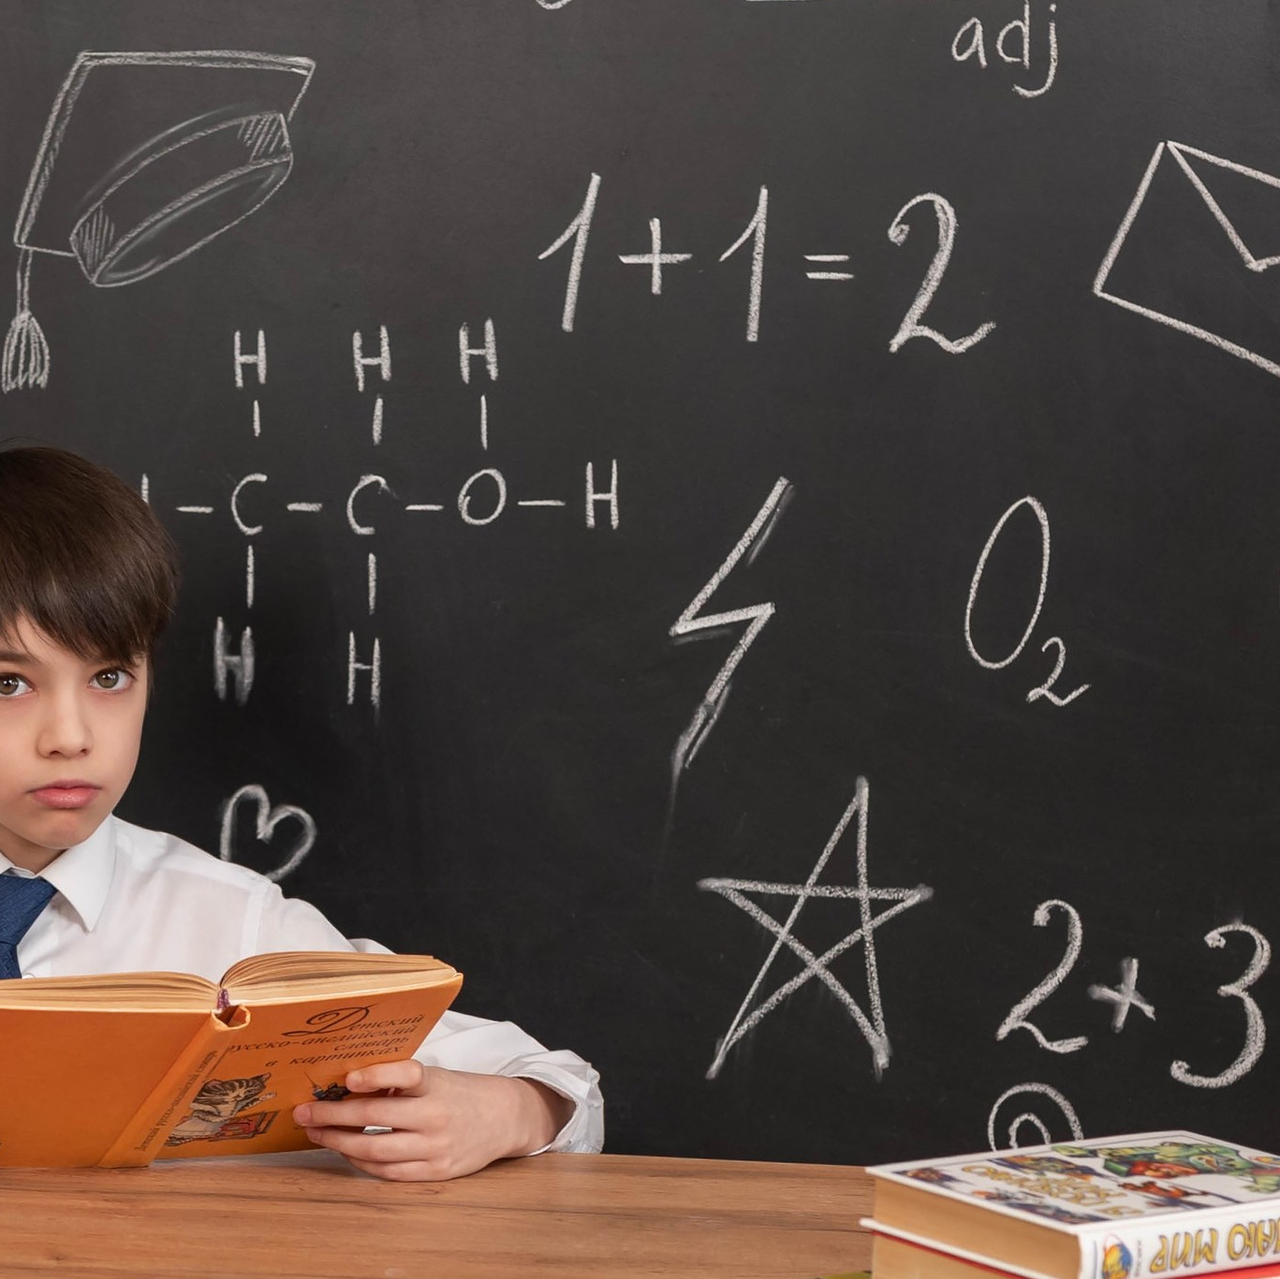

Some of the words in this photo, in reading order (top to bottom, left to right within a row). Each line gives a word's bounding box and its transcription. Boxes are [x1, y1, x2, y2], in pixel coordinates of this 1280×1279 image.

[233, 329, 266, 388] H
[352, 324, 391, 392] H
[457, 318, 499, 383] H
[584, 458, 619, 530] H
[213, 615, 256, 706] H
[346, 629, 382, 706] H
[280, 1004, 425, 1038] Детский
[219, 1026, 419, 1057] русско-английский
[289, 1046, 404, 1065] картинках
[333, 1036, 410, 1052] словарь
[1150, 1227, 1219, 1273] МИР
